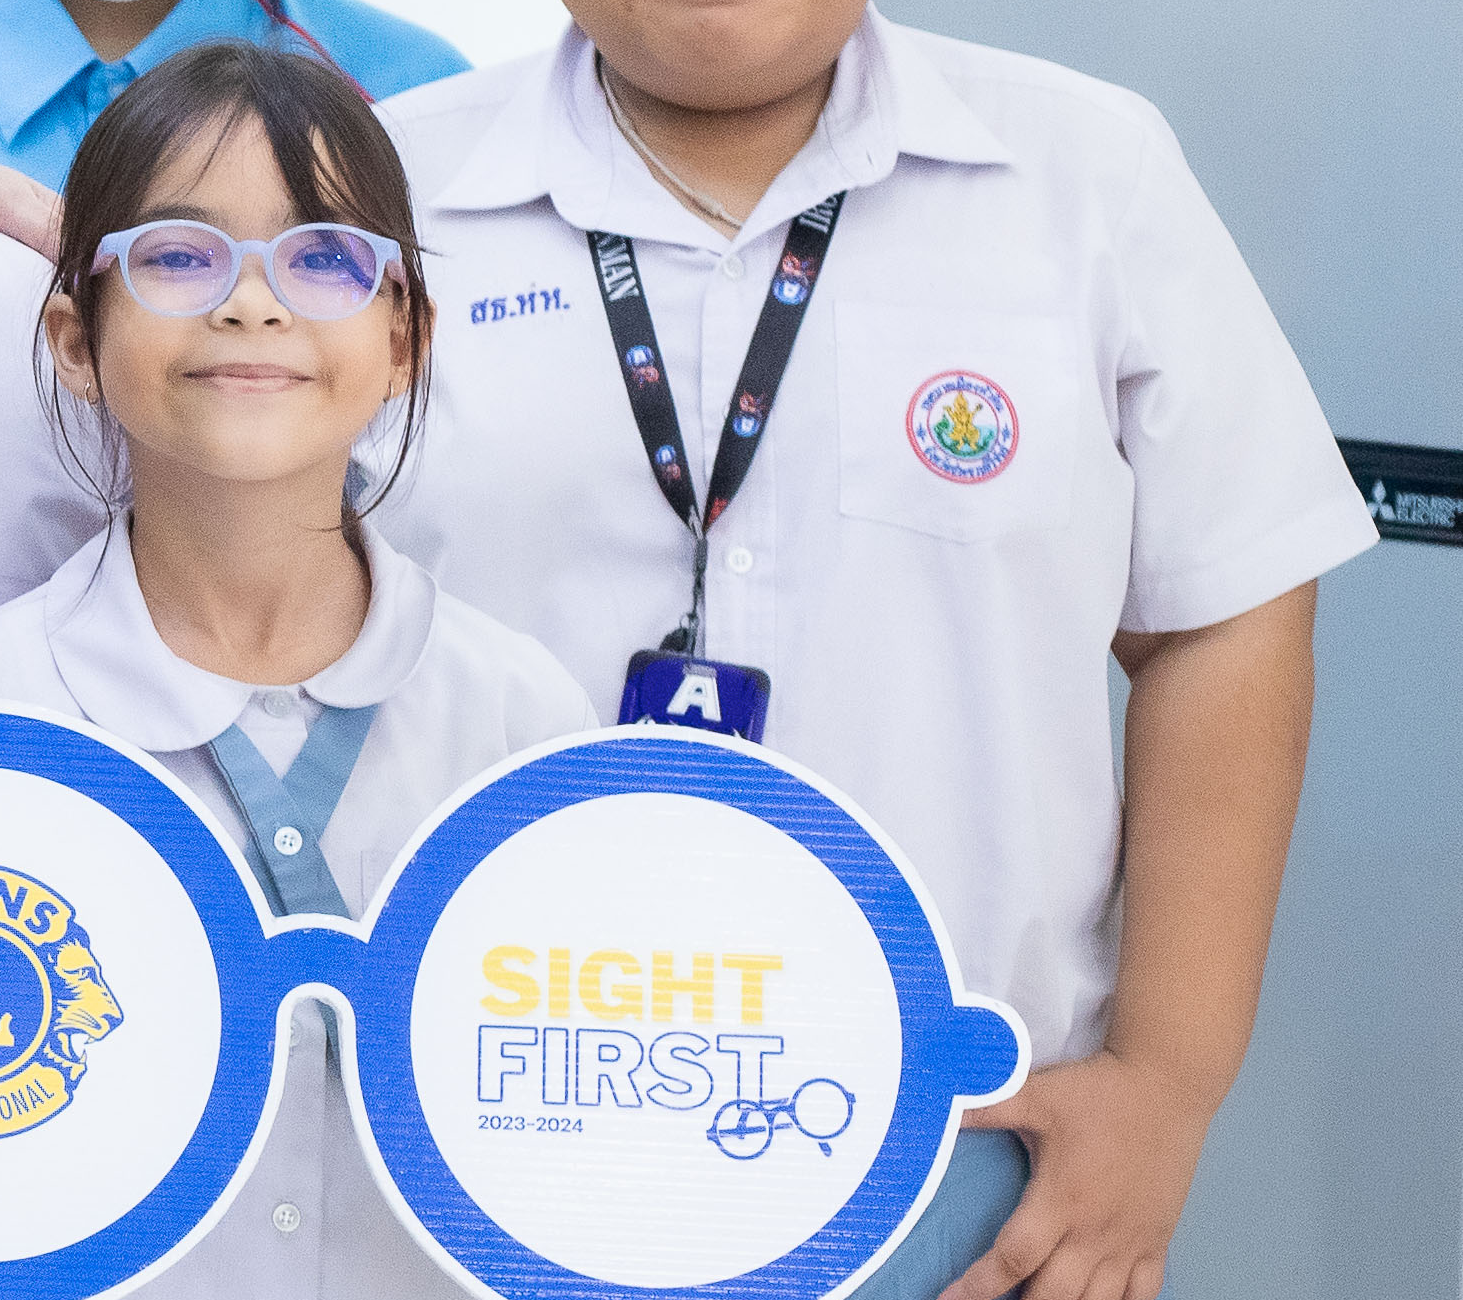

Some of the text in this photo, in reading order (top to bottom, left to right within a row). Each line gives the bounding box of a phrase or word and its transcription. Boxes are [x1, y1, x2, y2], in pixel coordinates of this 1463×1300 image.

[666, 673, 722, 723] A
[479, 944, 784, 1026] SIGHT
[477, 1024, 785, 1111] FIRST
[477, 1114, 584, 1134] 2023-2024
